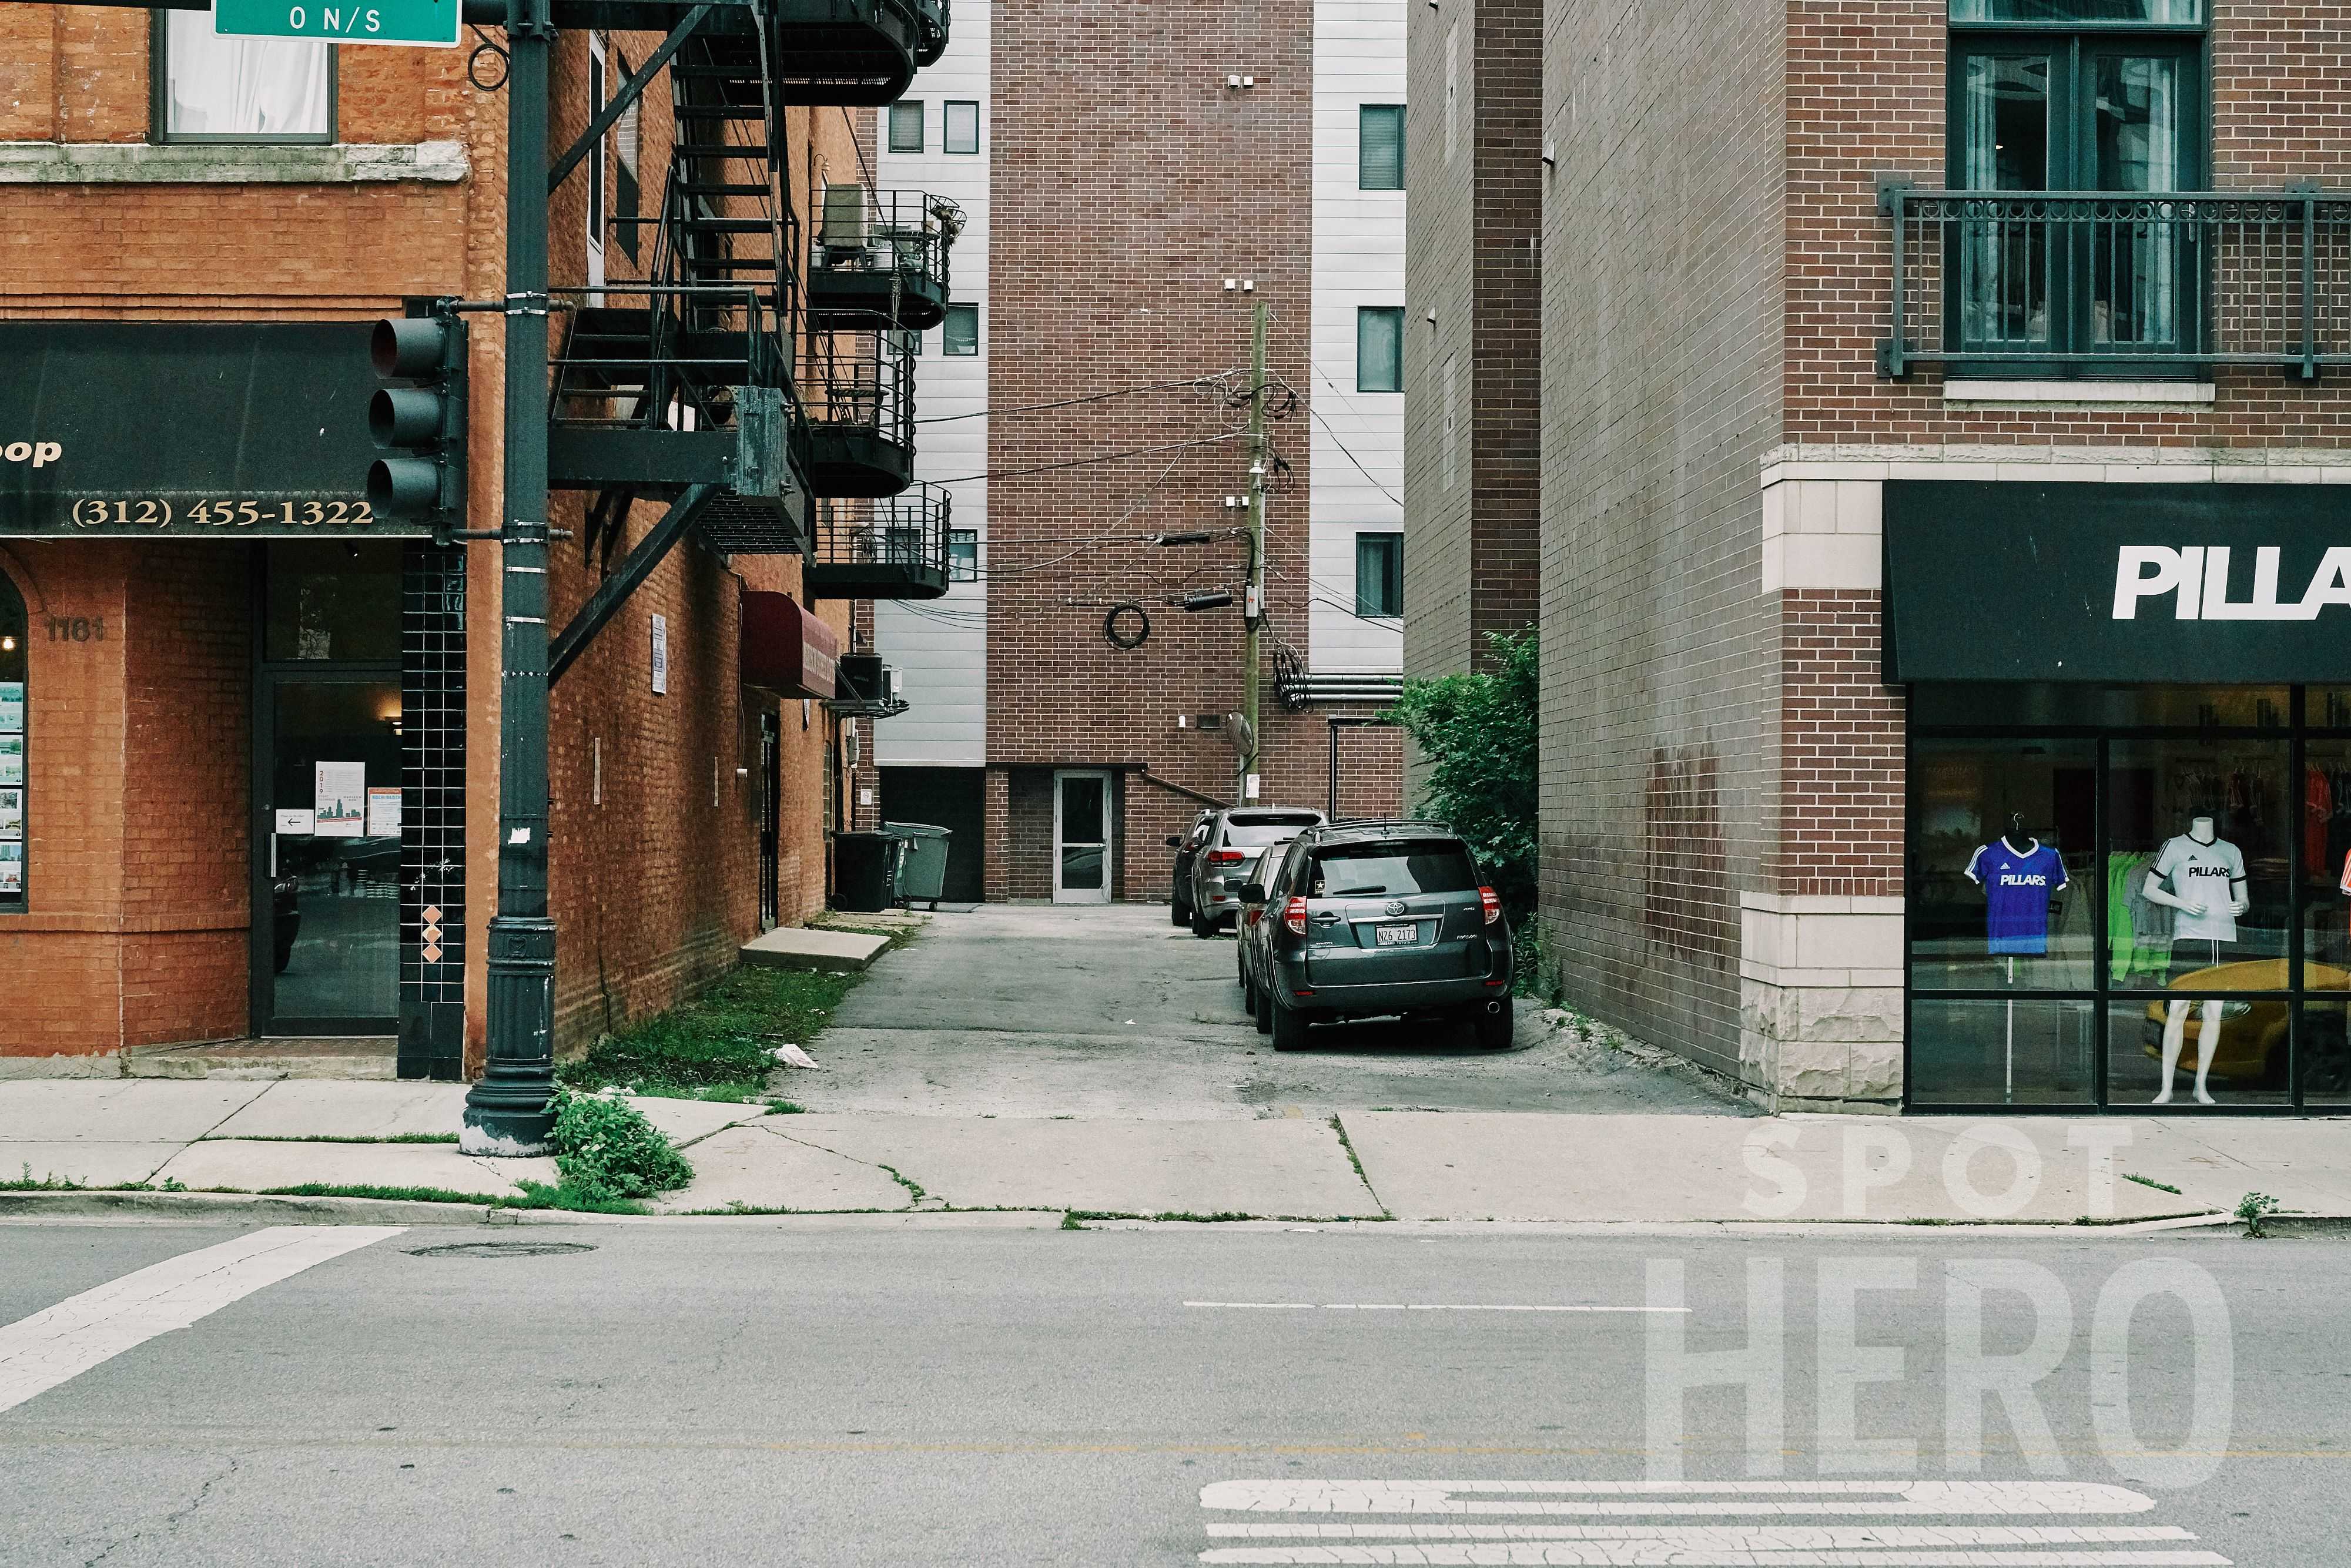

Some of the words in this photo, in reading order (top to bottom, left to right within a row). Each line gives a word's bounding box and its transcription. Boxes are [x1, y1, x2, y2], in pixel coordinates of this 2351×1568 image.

[324, 6, 380, 33] N/S
[0, 442, 62, 467] op
[72, 499, 172, 527] (312)
[187, 499, 374, 525] 455-1322
[2112, 545, 2351, 620] PILLA
[2000, 875, 2046, 886] PILLARS
[2189, 866, 2230, 877] PILLARS
[1378, 930, 1393, 942] N26
[1397, 929, 1416, 940] 2173
